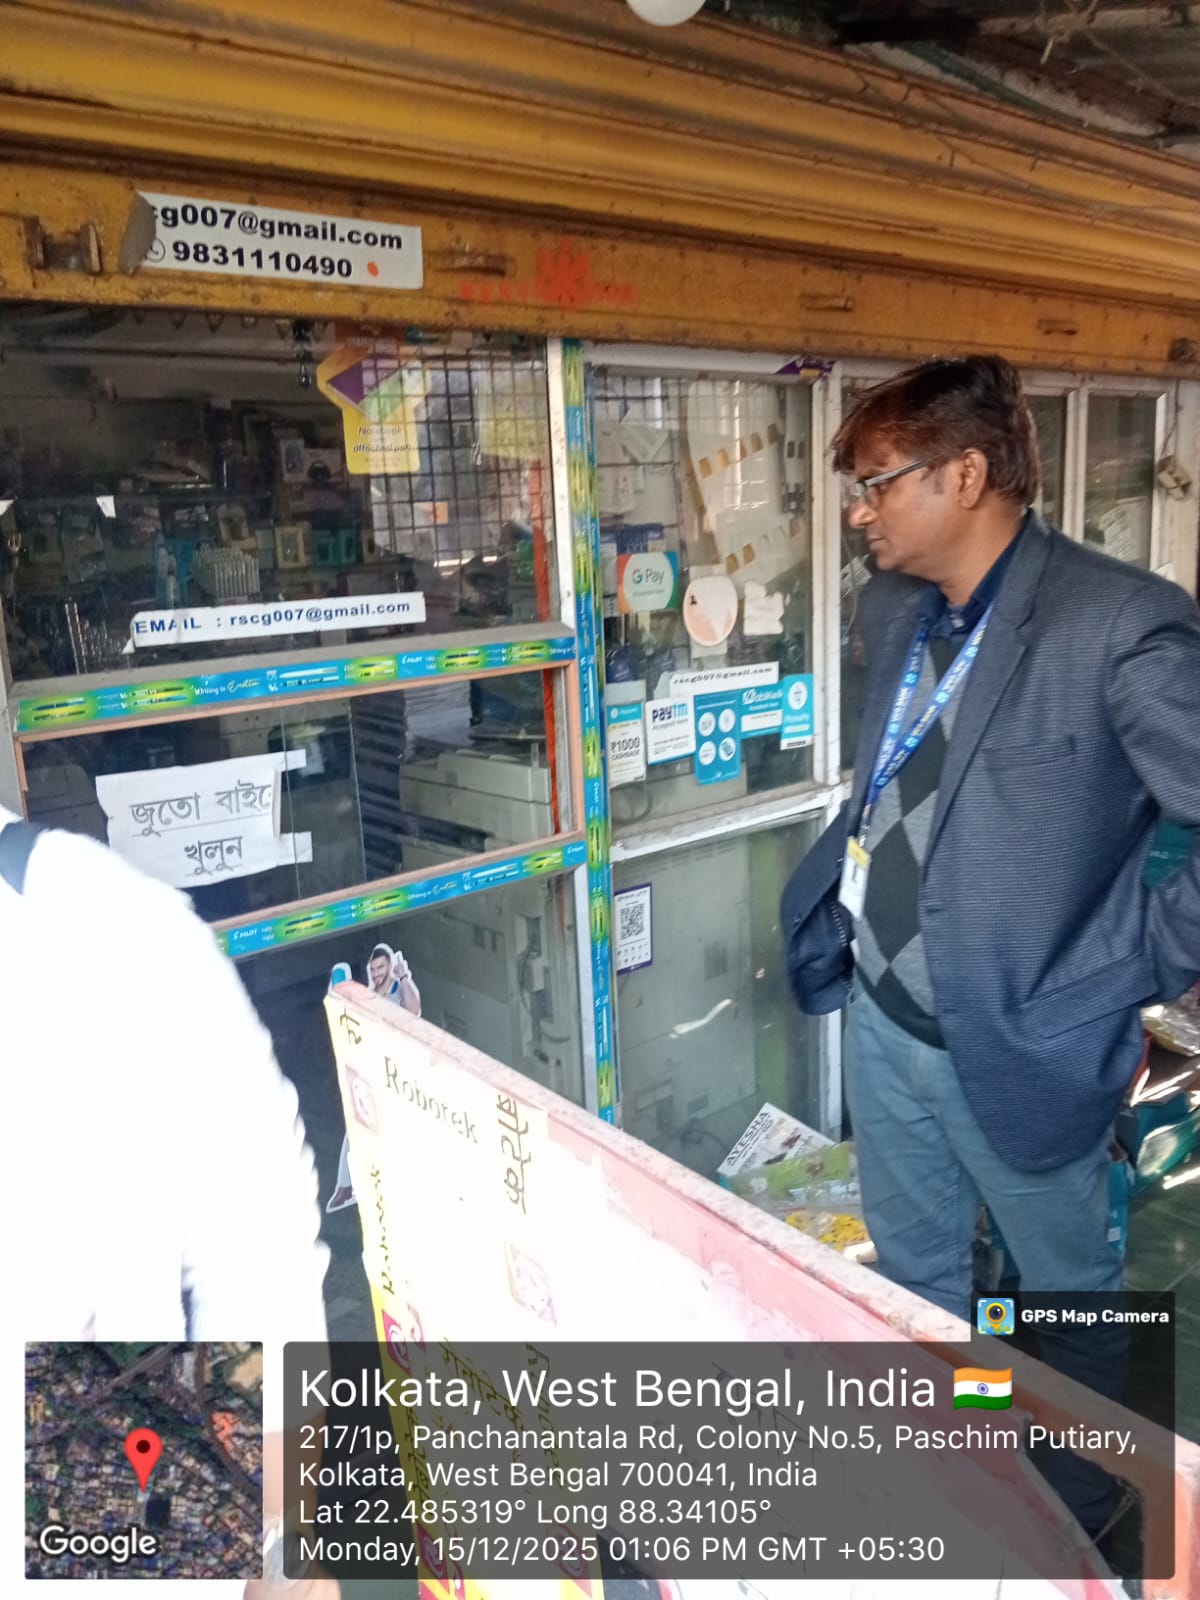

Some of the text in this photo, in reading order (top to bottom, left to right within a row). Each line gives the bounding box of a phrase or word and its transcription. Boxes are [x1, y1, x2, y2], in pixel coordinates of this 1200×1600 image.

[172, 240, 352, 277] 9831110490
[632, 567, 665, 585] G Pay
[230, 601, 410, 626] rscg007@gmail.com
[184, 835, 242, 875] খুলুন
[727, 1111, 770, 1167] AYESHA
